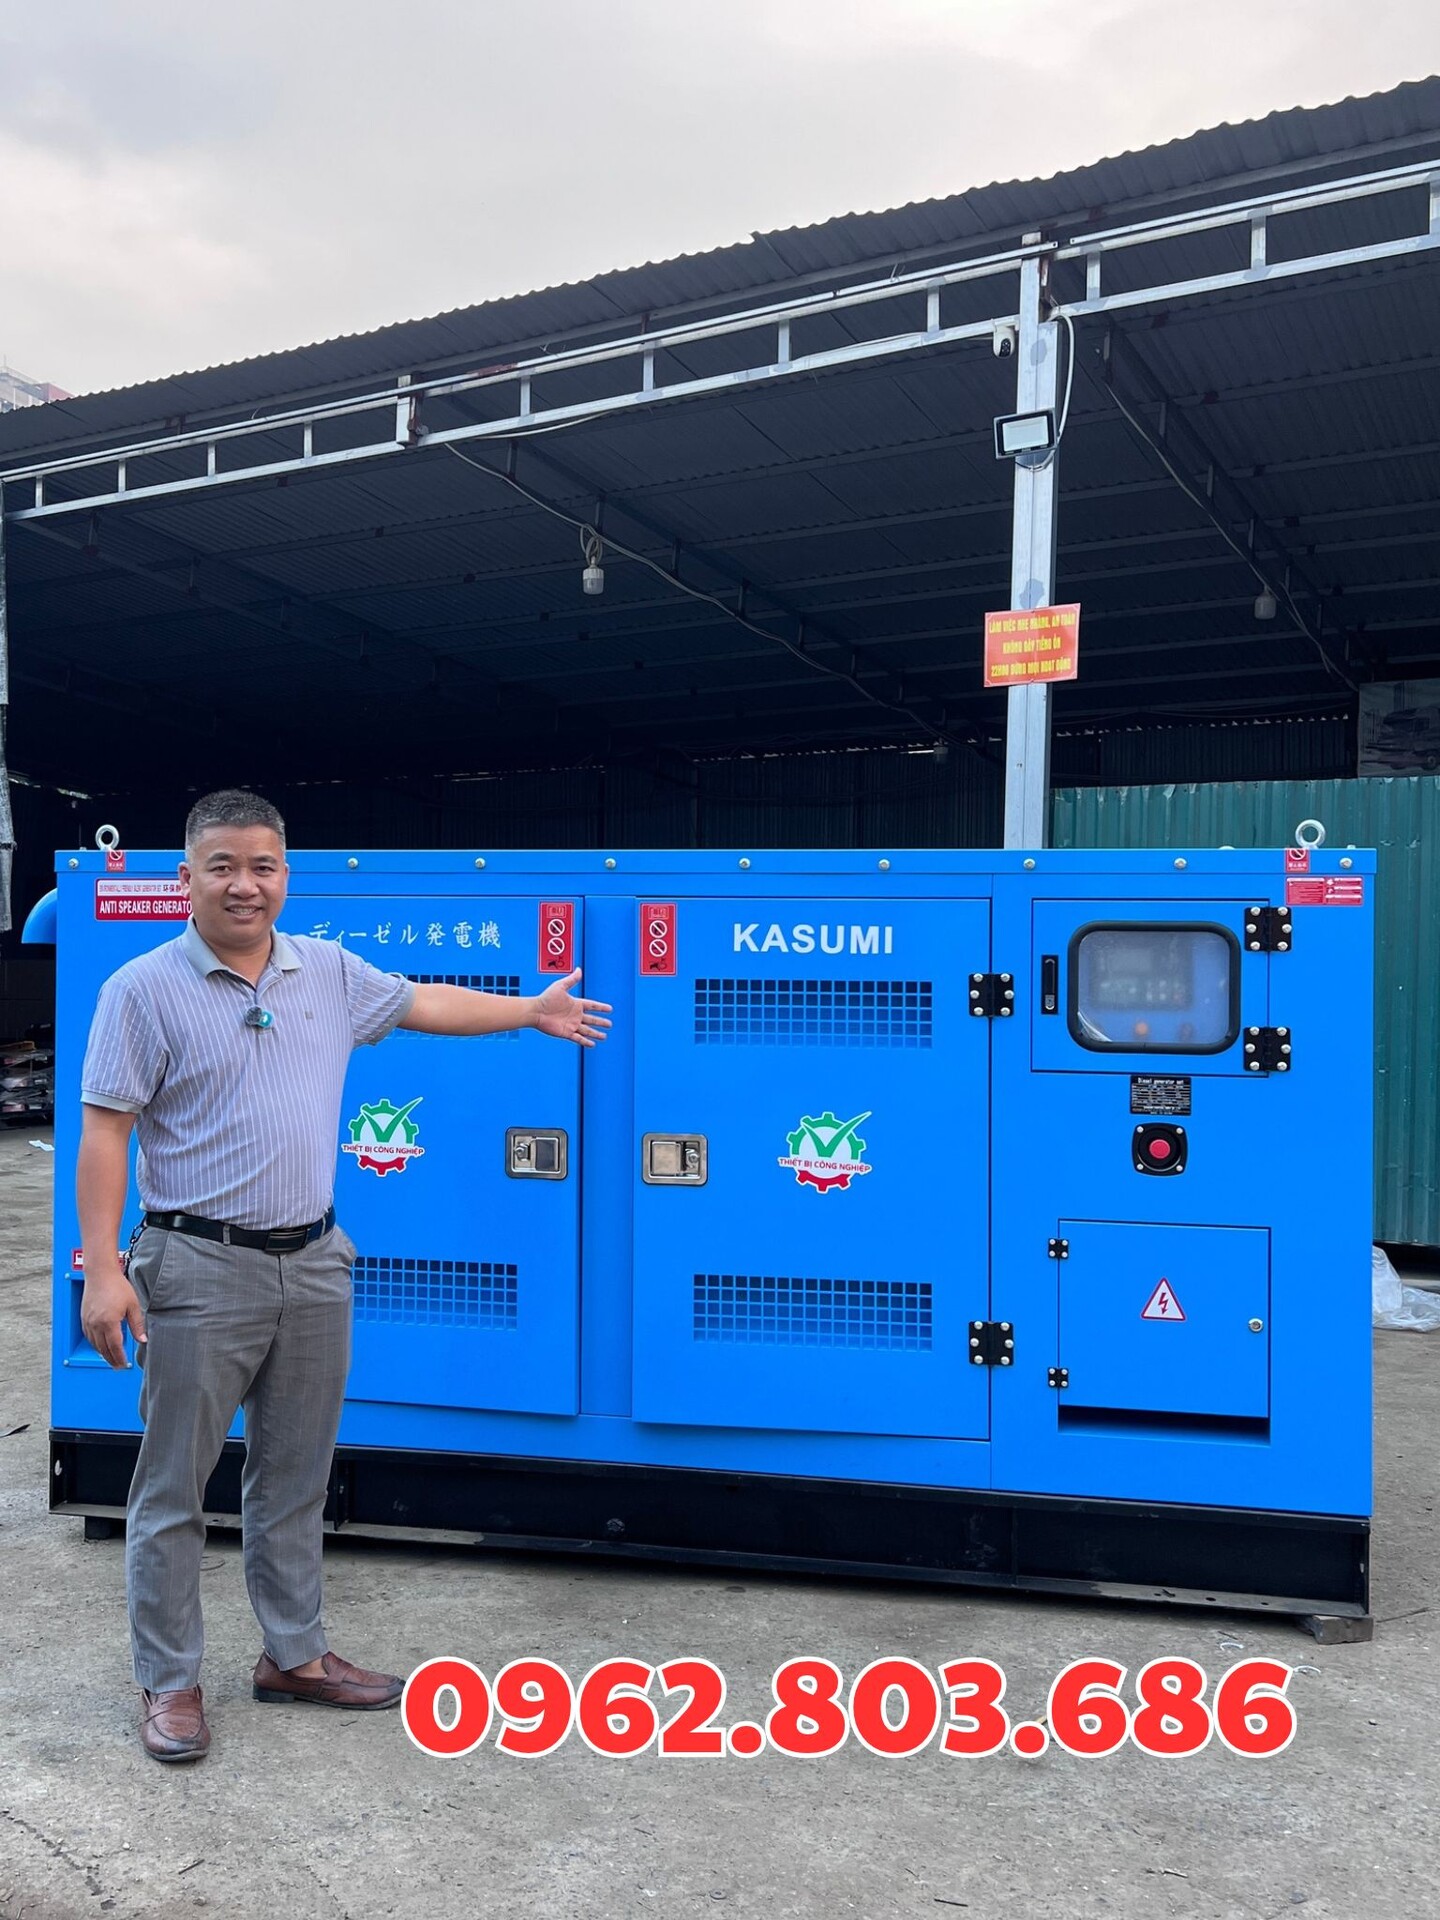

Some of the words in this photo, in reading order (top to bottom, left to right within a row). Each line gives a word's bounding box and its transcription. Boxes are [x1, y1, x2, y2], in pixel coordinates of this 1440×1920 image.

[99, 900, 117, 914] ANTI
[118, 900, 152, 914] SPEAKER
[152, 900, 193, 914] GENERATO
[733, 923, 893, 955] KASUMI
[373, 1145, 395, 1154] CÔNG
[804, 1160, 812, 1169] BỊ
[814, 1160, 837, 1170] CÔNG
[839, 1163, 871, 1172] NGHIỆP
